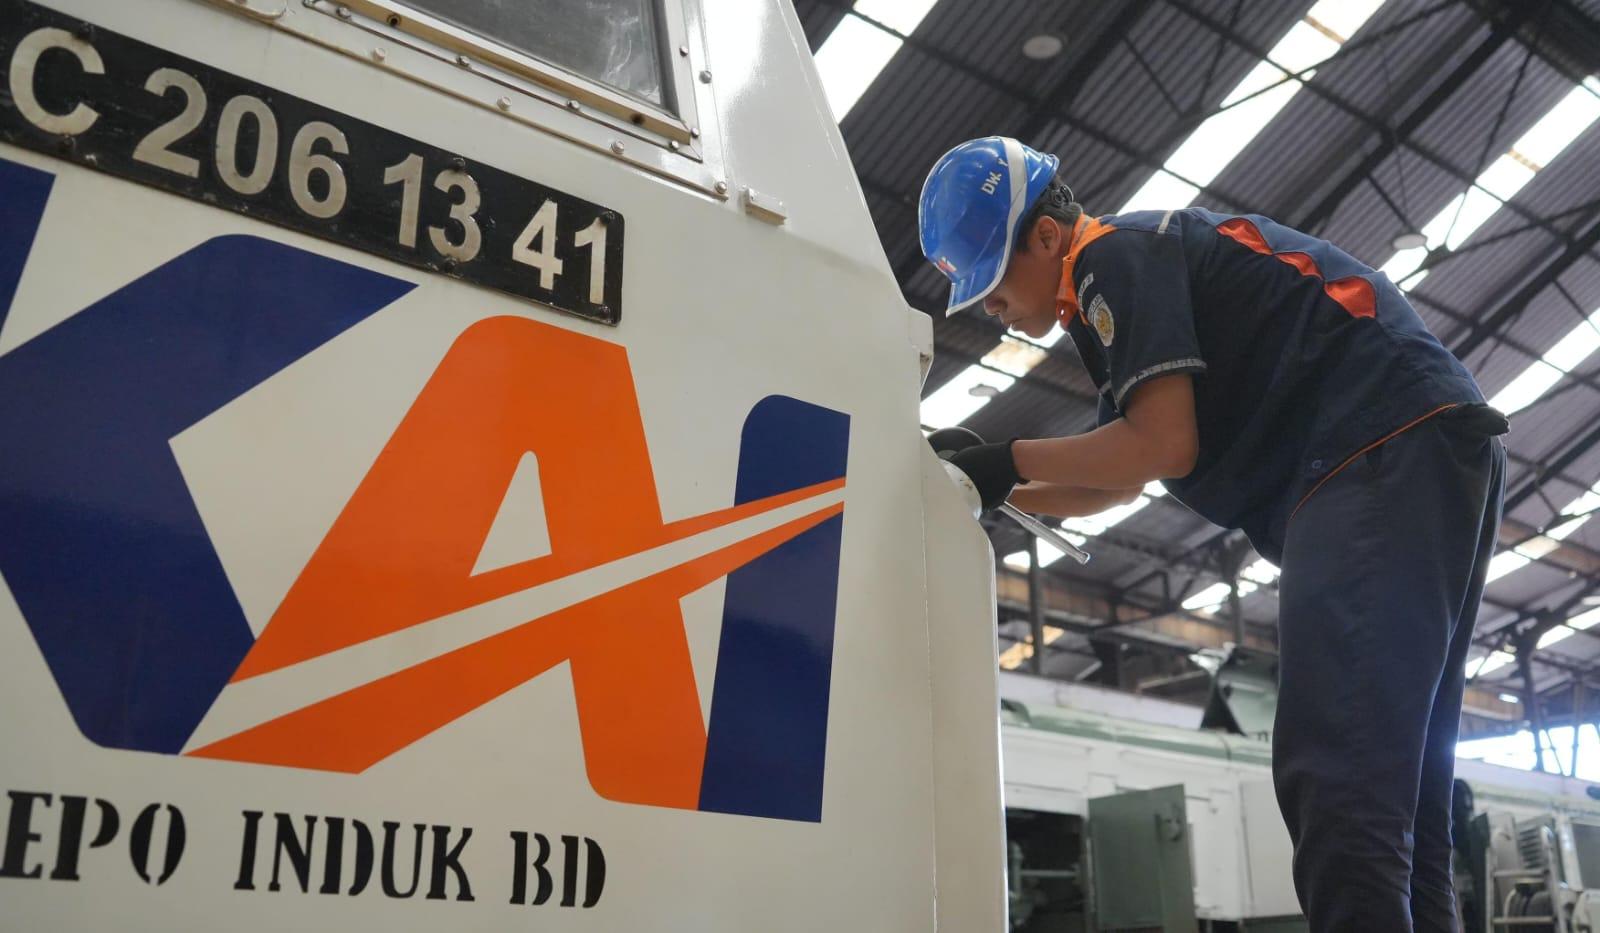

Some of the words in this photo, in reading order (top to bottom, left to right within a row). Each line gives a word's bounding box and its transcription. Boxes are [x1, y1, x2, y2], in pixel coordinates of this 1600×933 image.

[9, 27, 106, 136] C
[132, 68, 350, 219] 206
[383, 153, 482, 264] 13
[512, 199, 608, 305] 41
[0, 159, 851, 822] KAI
[0, 790, 187, 886] EPO
[233, 810, 476, 902] INDUK
[509, 830, 607, 909] BD
